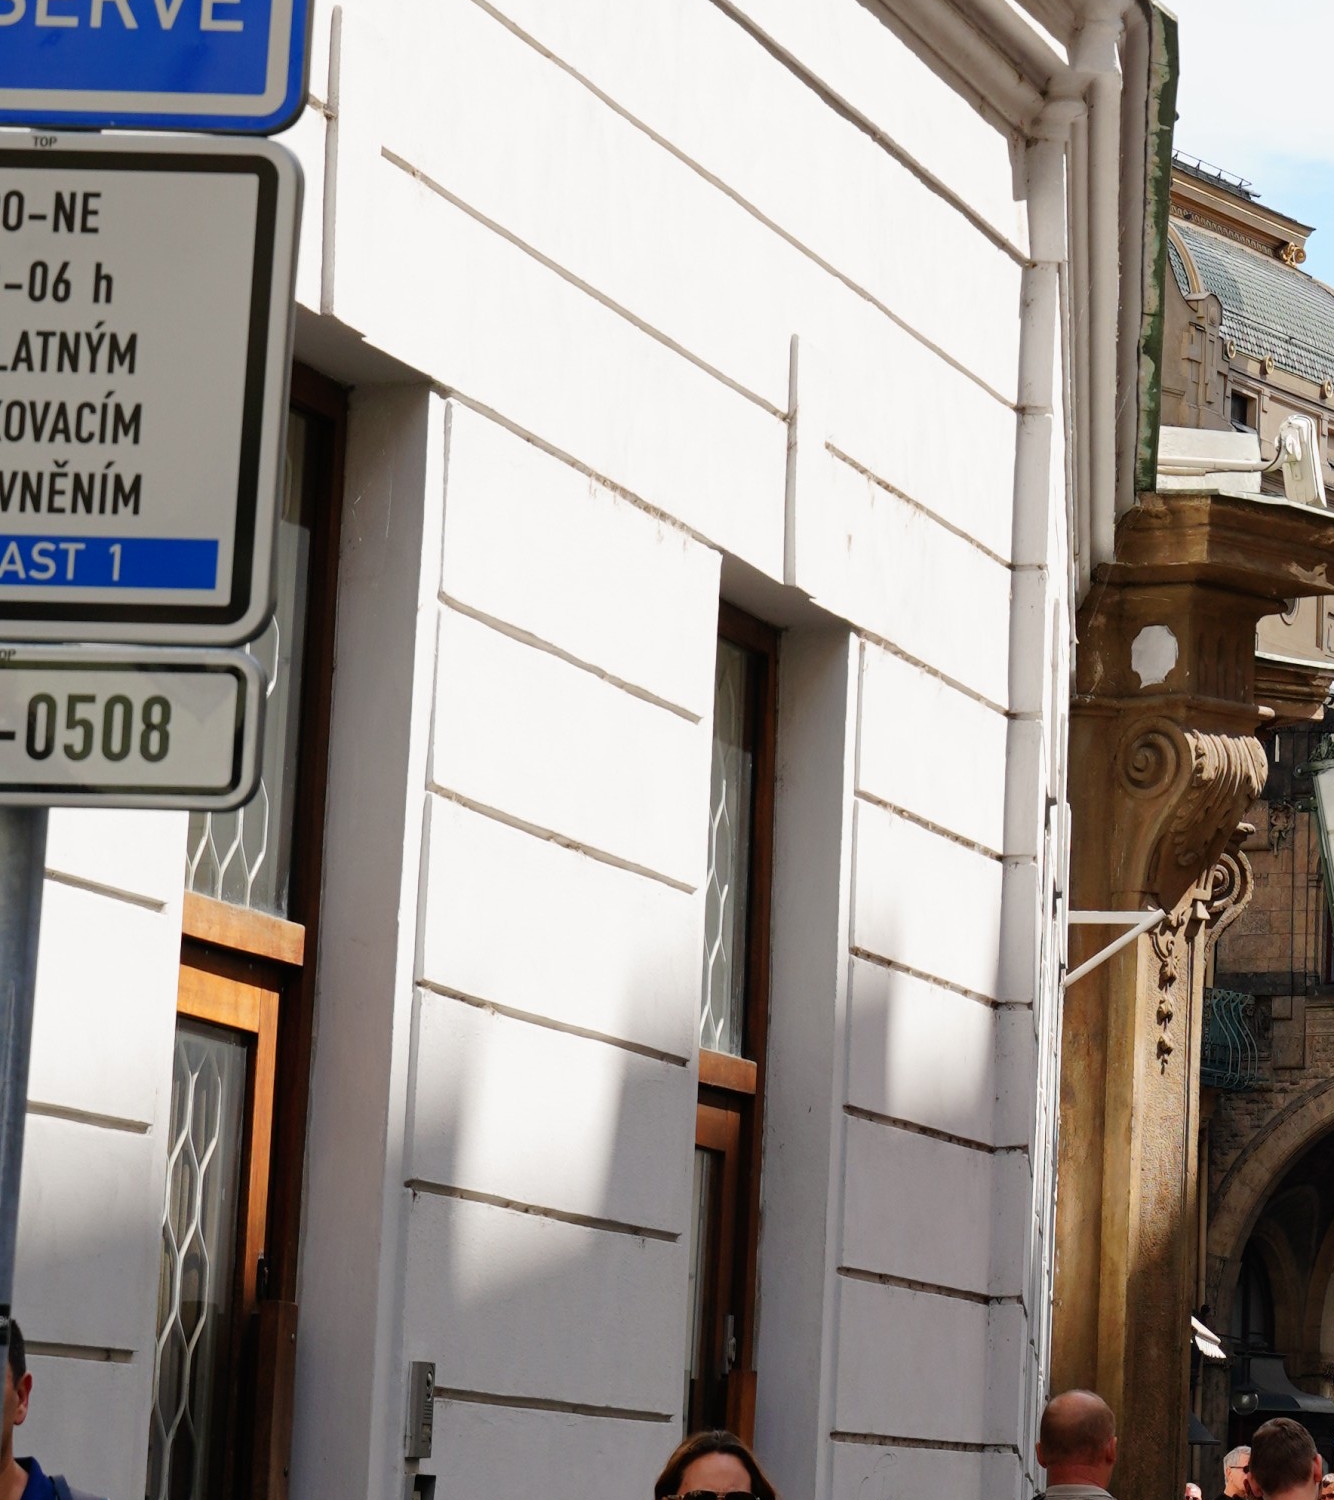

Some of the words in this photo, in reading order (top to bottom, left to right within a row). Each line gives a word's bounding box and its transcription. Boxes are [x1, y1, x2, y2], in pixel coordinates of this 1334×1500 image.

[33, 136, 58, 148] TOP
[93, 262, 114, 304] h
[0, 320, 138, 375] ATNÝM
[0, 390, 142, 445] OVACÍM
[0, 540, 87, 581] AST
[109, 543, 123, 582] 1
